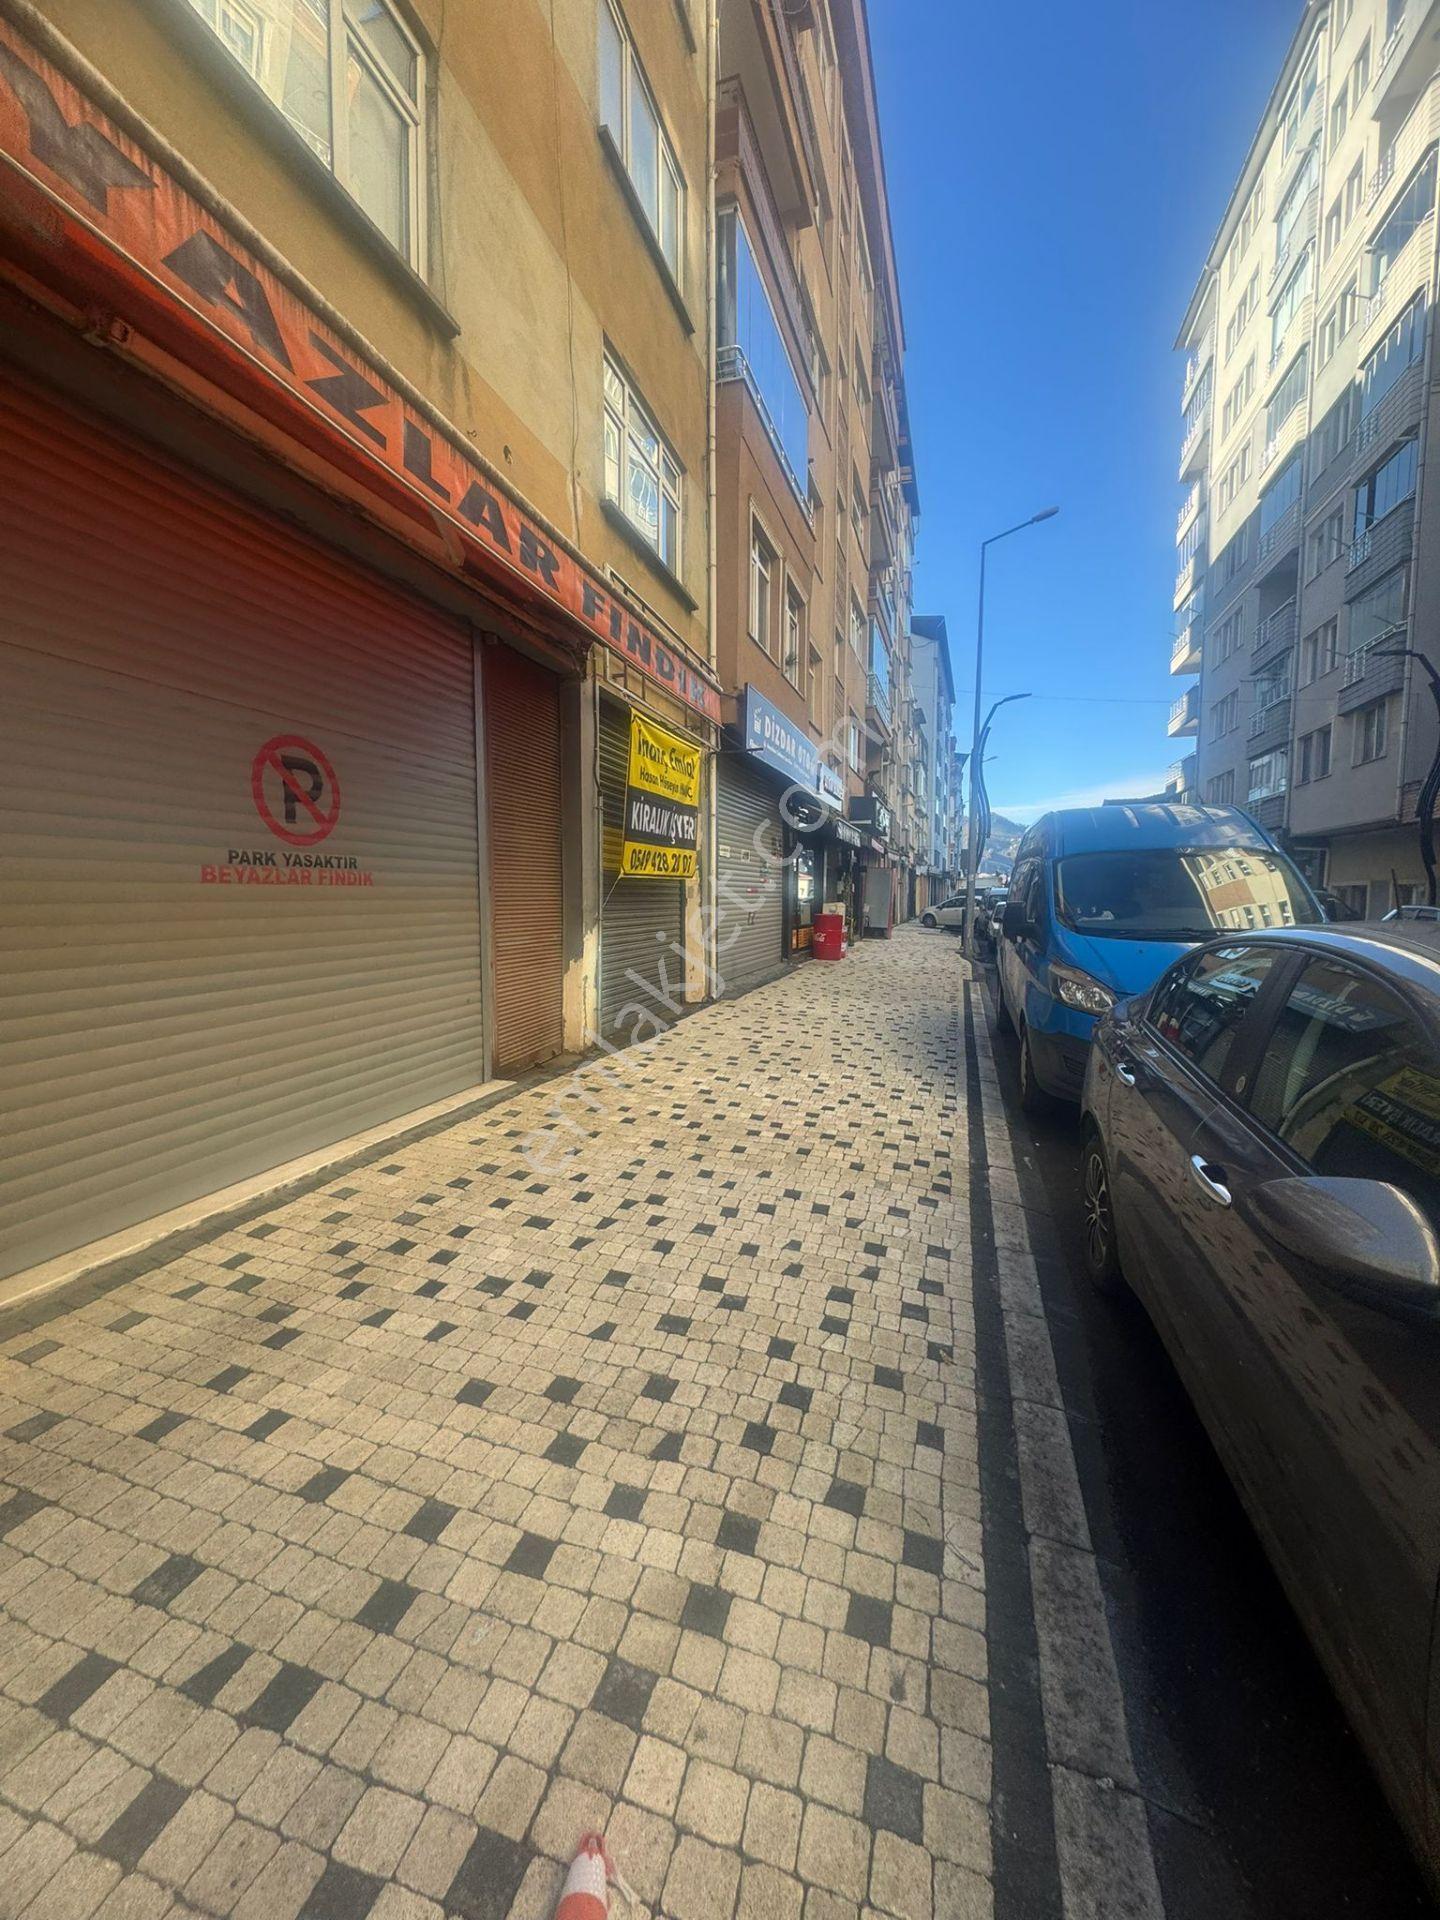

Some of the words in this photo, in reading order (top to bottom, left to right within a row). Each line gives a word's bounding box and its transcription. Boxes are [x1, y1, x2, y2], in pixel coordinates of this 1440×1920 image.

[631, 796, 670, 837] KİRALIK
[228, 850, 276, 866] PARK
[282, 852, 358, 869] YASAKTIR
[200, 864, 313, 886] BEYAZLAR
[318, 870, 374, 887] FINDIK
